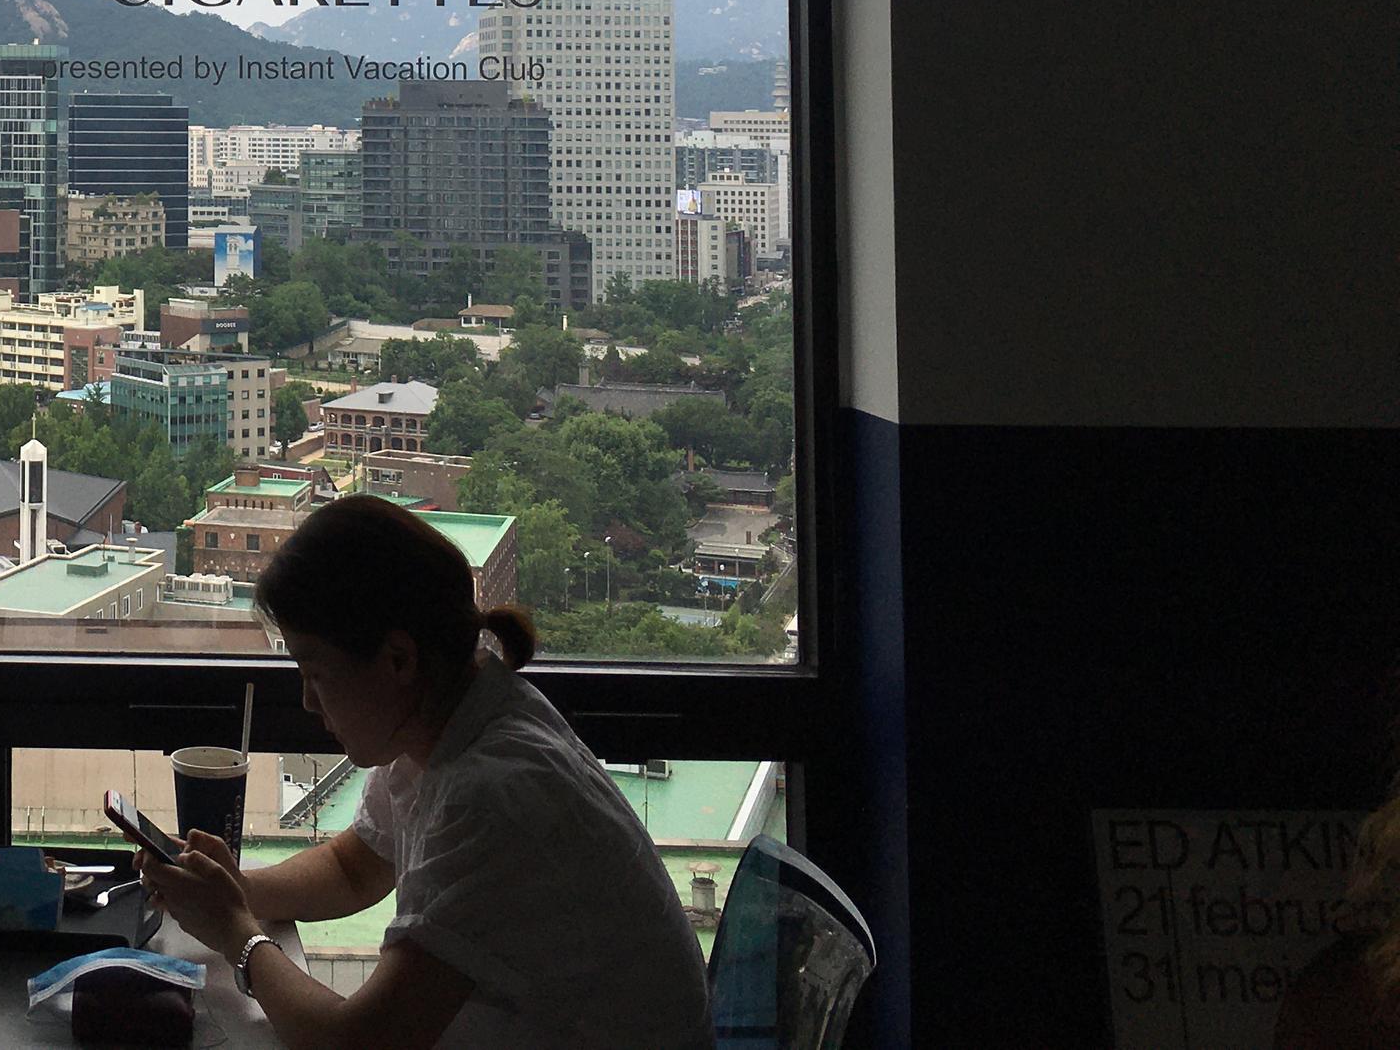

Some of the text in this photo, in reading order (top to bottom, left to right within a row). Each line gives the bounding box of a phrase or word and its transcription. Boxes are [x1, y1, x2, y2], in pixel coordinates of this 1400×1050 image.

[42, 55, 545, 85] presented by Instant Vacation Club
[1108, 820, 1190, 870] ED
[1113, 885, 1172, 936] 21
[1120, 951, 1178, 1004] 31
